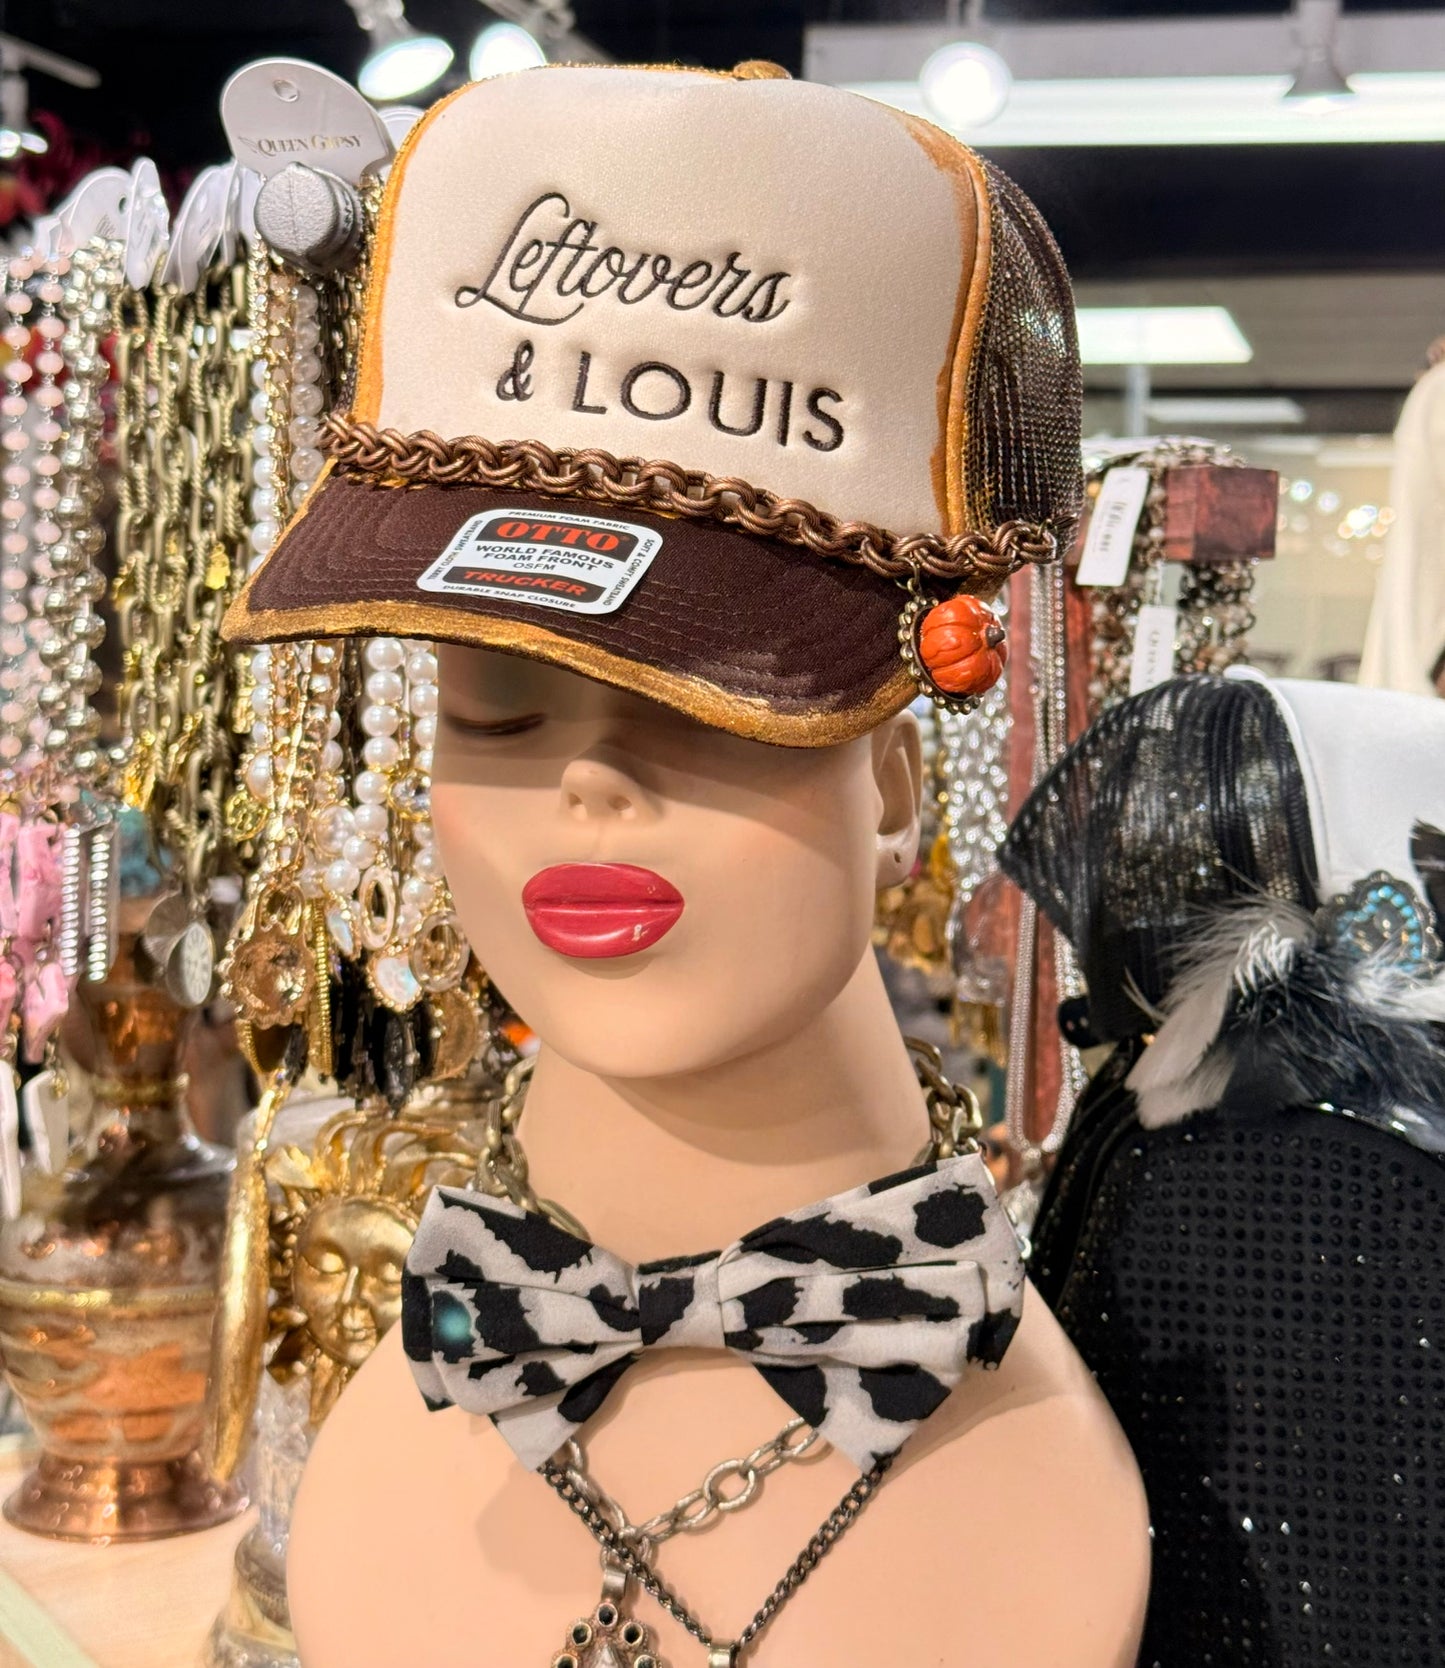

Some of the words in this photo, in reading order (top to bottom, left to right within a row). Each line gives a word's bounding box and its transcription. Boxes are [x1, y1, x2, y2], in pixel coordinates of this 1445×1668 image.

[257, 138, 309, 157] QUEEN
[454, 191, 793, 326] Leftovers
[496, 339, 534, 402] &
[571, 350, 845, 452] LOUIS
[508, 511, 556, 520] PREMIUM
[560, 515, 590, 524] FOAM
[592, 519, 630, 531] FABRIC
[454, 519, 484, 551] SWEATBAND
[496, 521, 619, 551] OTTO
[641, 538, 655, 554] SOFT
[476, 545, 537, 555] WORLD
[542, 548, 614, 569] FAMOUS
[483, 552, 533, 562] FOAM
[537, 555, 598, 571] FRONT
[513, 562, 556, 571] OSFM
[626, 558, 642, 577] COMFY
[463, 571, 588, 597] TRUCKER
[602, 576, 629, 606] SWEATBAND
[443, 585, 491, 594] DURABLE
[494, 590, 525, 599] SNAP
[528, 594, 576, 608] CLOSURE
